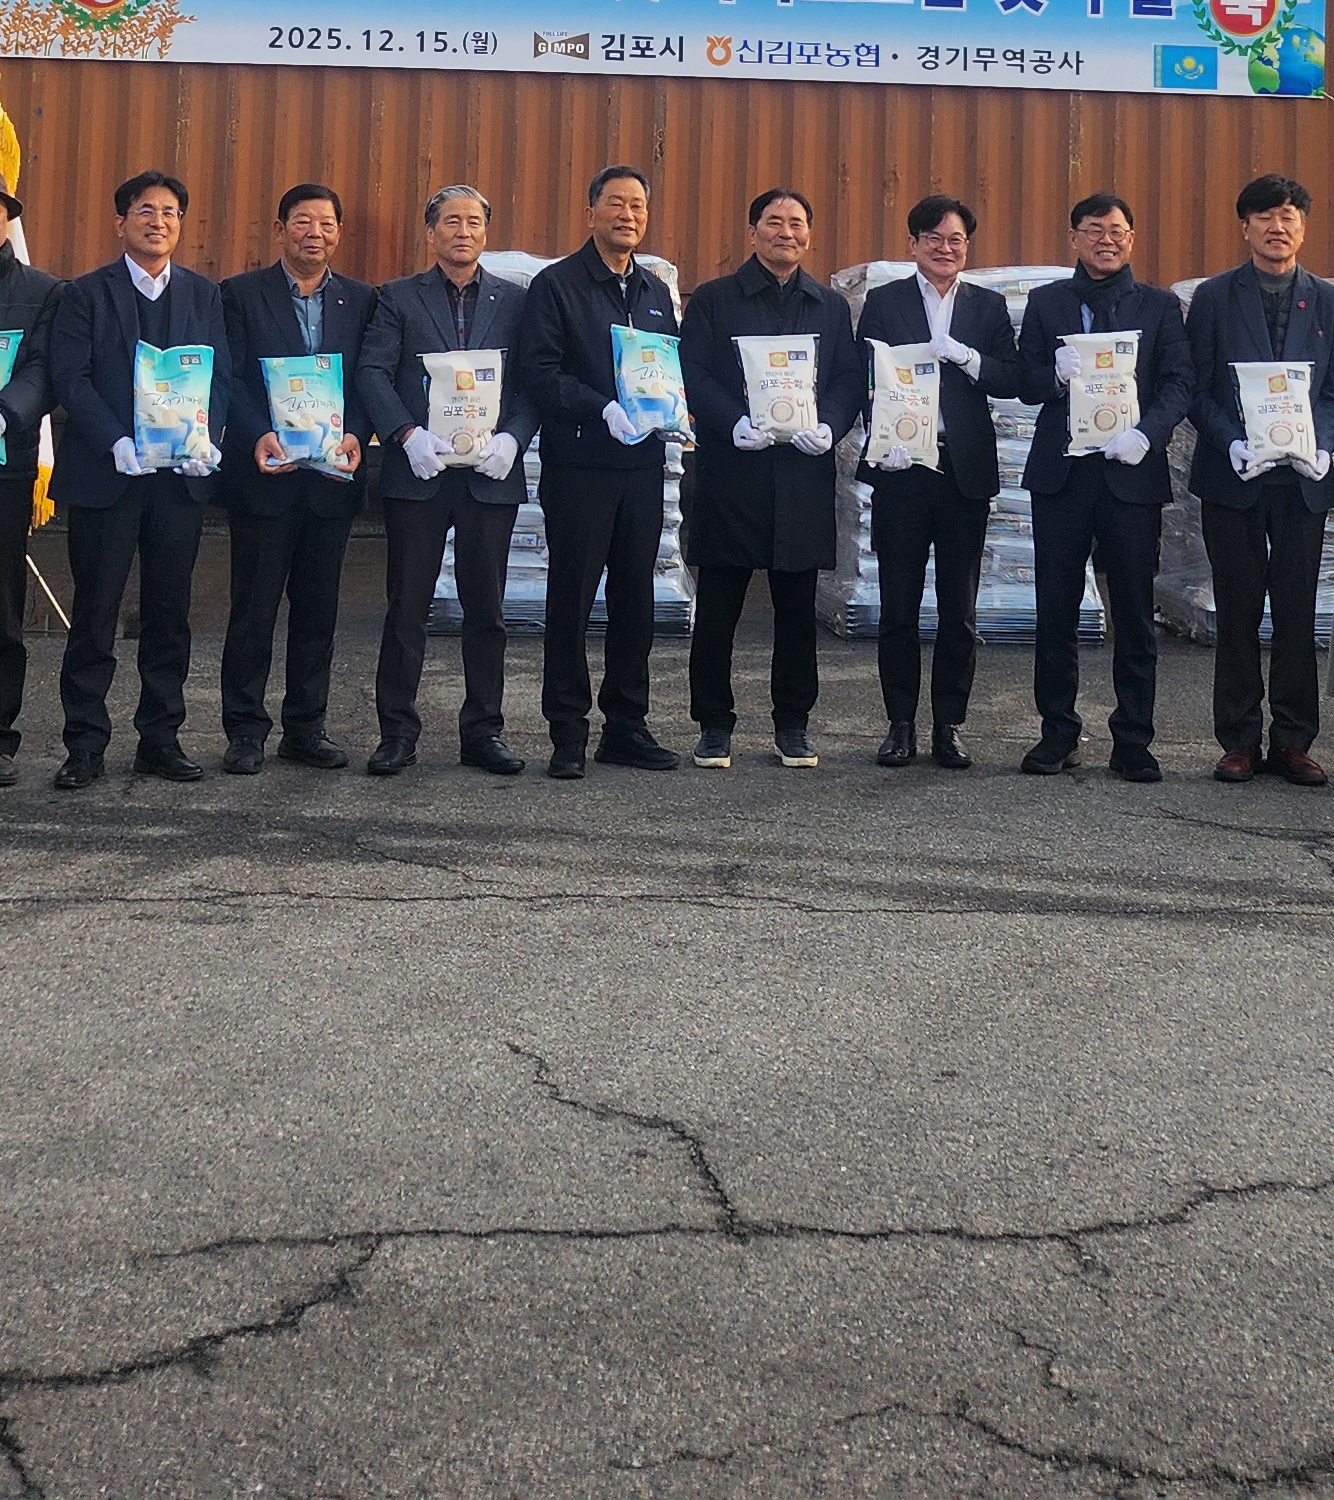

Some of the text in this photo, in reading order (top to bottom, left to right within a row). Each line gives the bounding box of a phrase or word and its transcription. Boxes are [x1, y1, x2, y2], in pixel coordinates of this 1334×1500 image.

[537, 42, 585, 54] GIMPO
[601, 34, 684, 63] 김포시
[735, 38, 1084, 76] 신김포농협 경기무역공사
